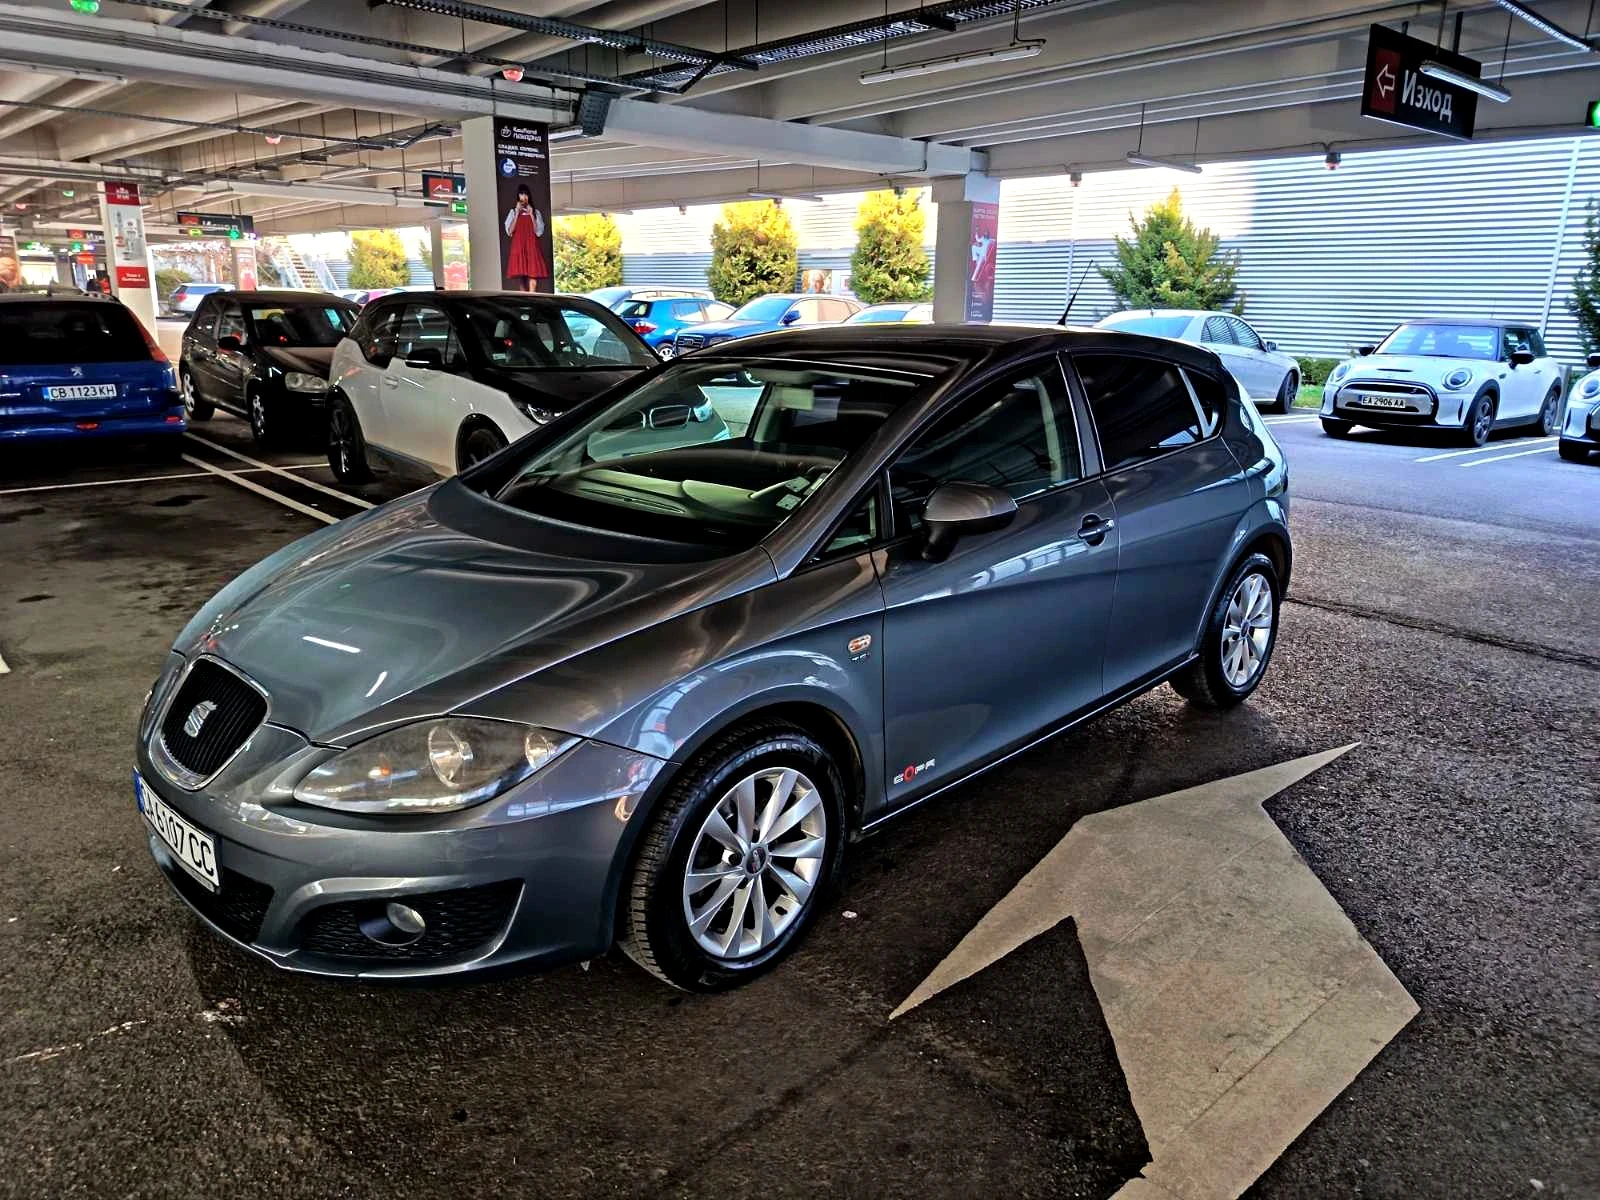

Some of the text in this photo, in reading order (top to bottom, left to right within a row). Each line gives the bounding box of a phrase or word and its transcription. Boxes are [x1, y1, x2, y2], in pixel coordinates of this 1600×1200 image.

[1401, 69, 1453, 124] Изход
[50, 385, 114, 399] CB 1123 KH
[188, 832, 214, 877] CC
